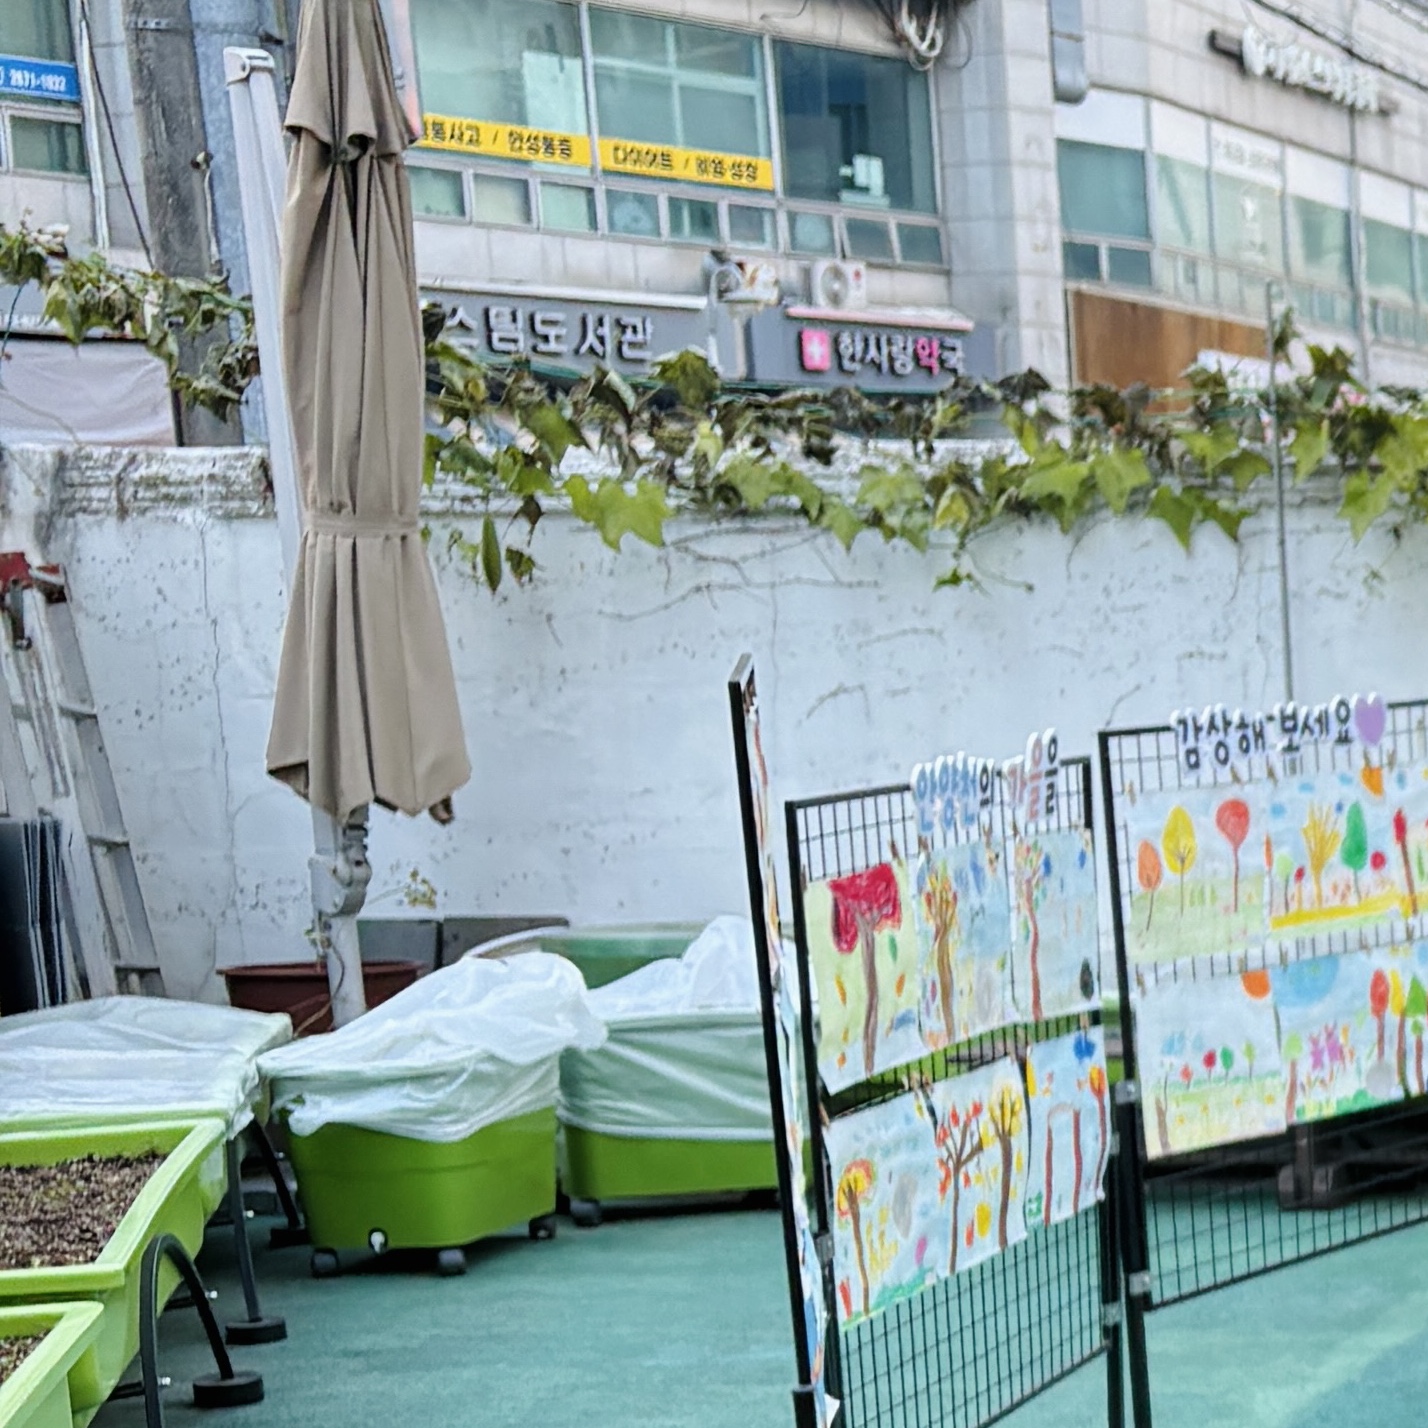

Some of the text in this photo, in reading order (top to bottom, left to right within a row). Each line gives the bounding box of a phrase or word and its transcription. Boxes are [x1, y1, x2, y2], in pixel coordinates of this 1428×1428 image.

[836, 329, 967, 377] 한사랑약국
[1176, 699, 1352, 770] 감상해 보세요
